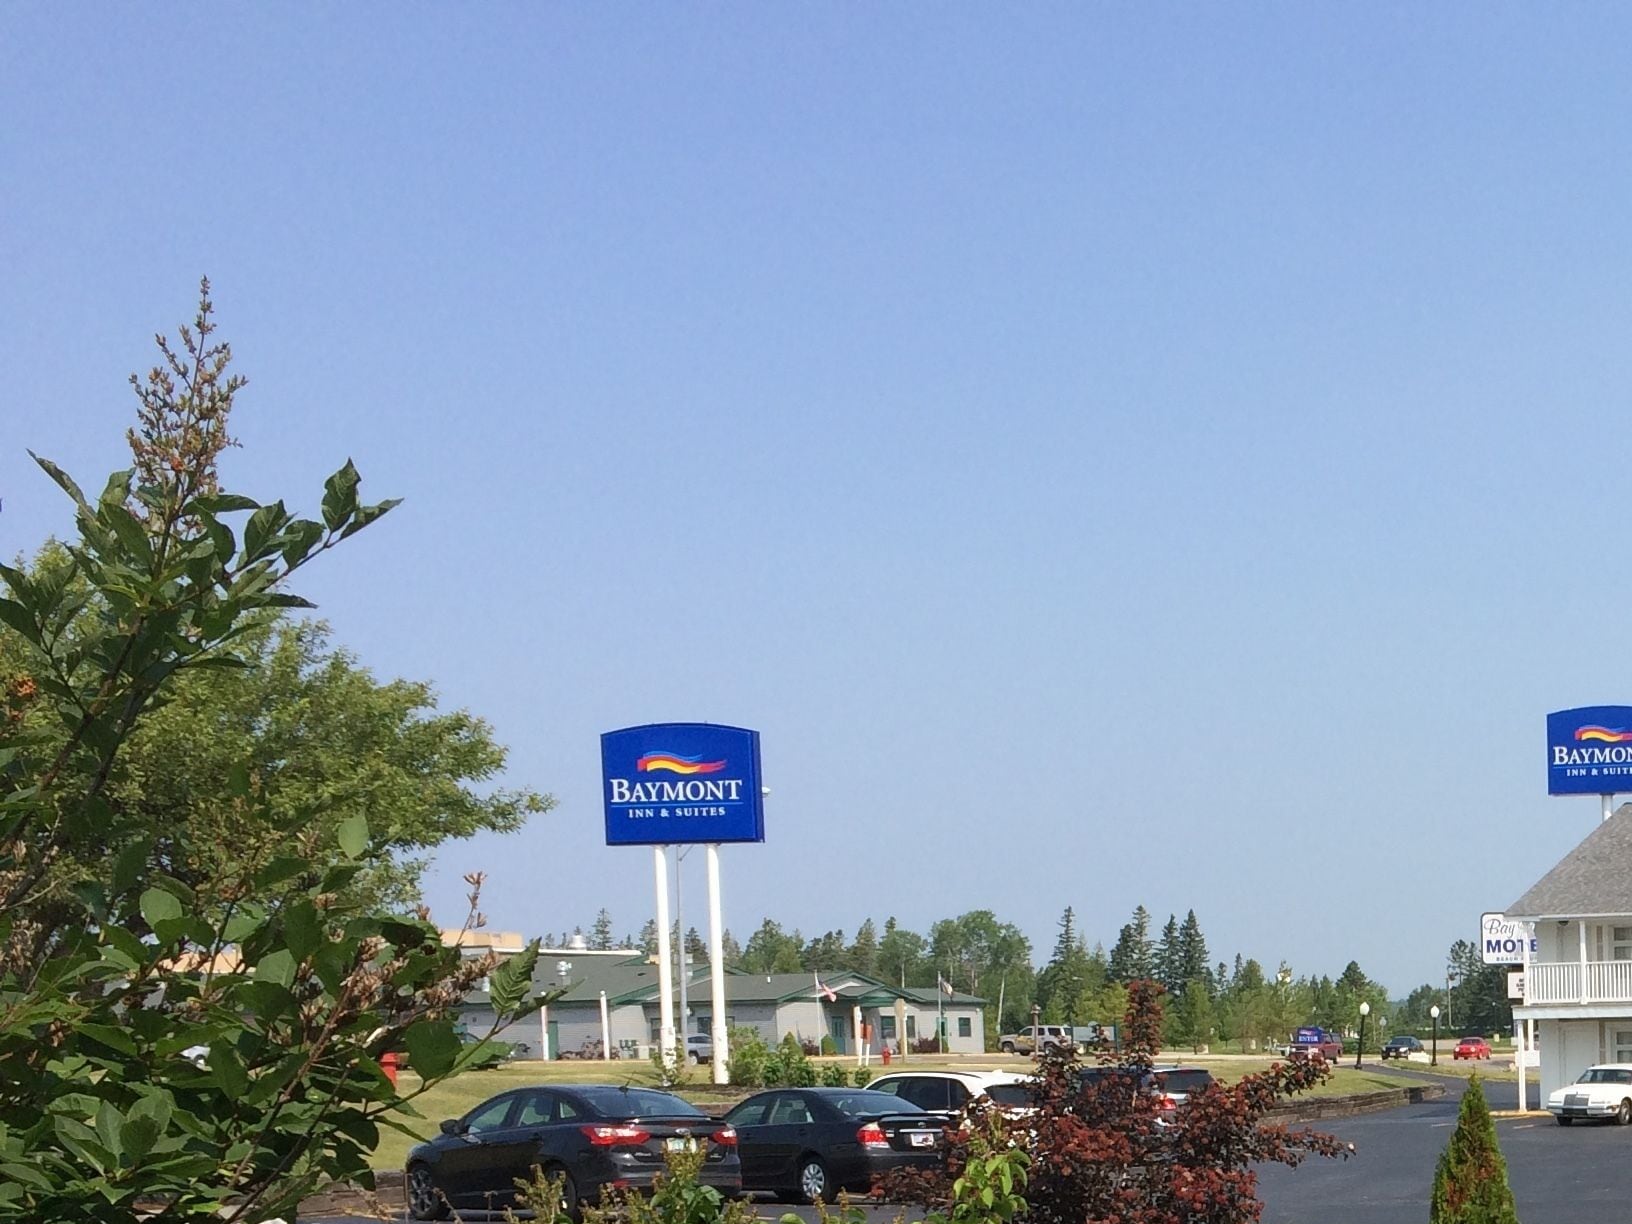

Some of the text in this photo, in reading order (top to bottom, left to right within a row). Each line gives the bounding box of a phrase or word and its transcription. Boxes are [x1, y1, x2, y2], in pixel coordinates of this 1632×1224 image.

[1566, 768, 1587, 777] INN
[1591, 768, 1599, 776] &
[609, 778, 743, 803] BAYMONT
[628, 806, 727, 819] INN & SUITES
[1484, 918, 1516, 939] Bay
